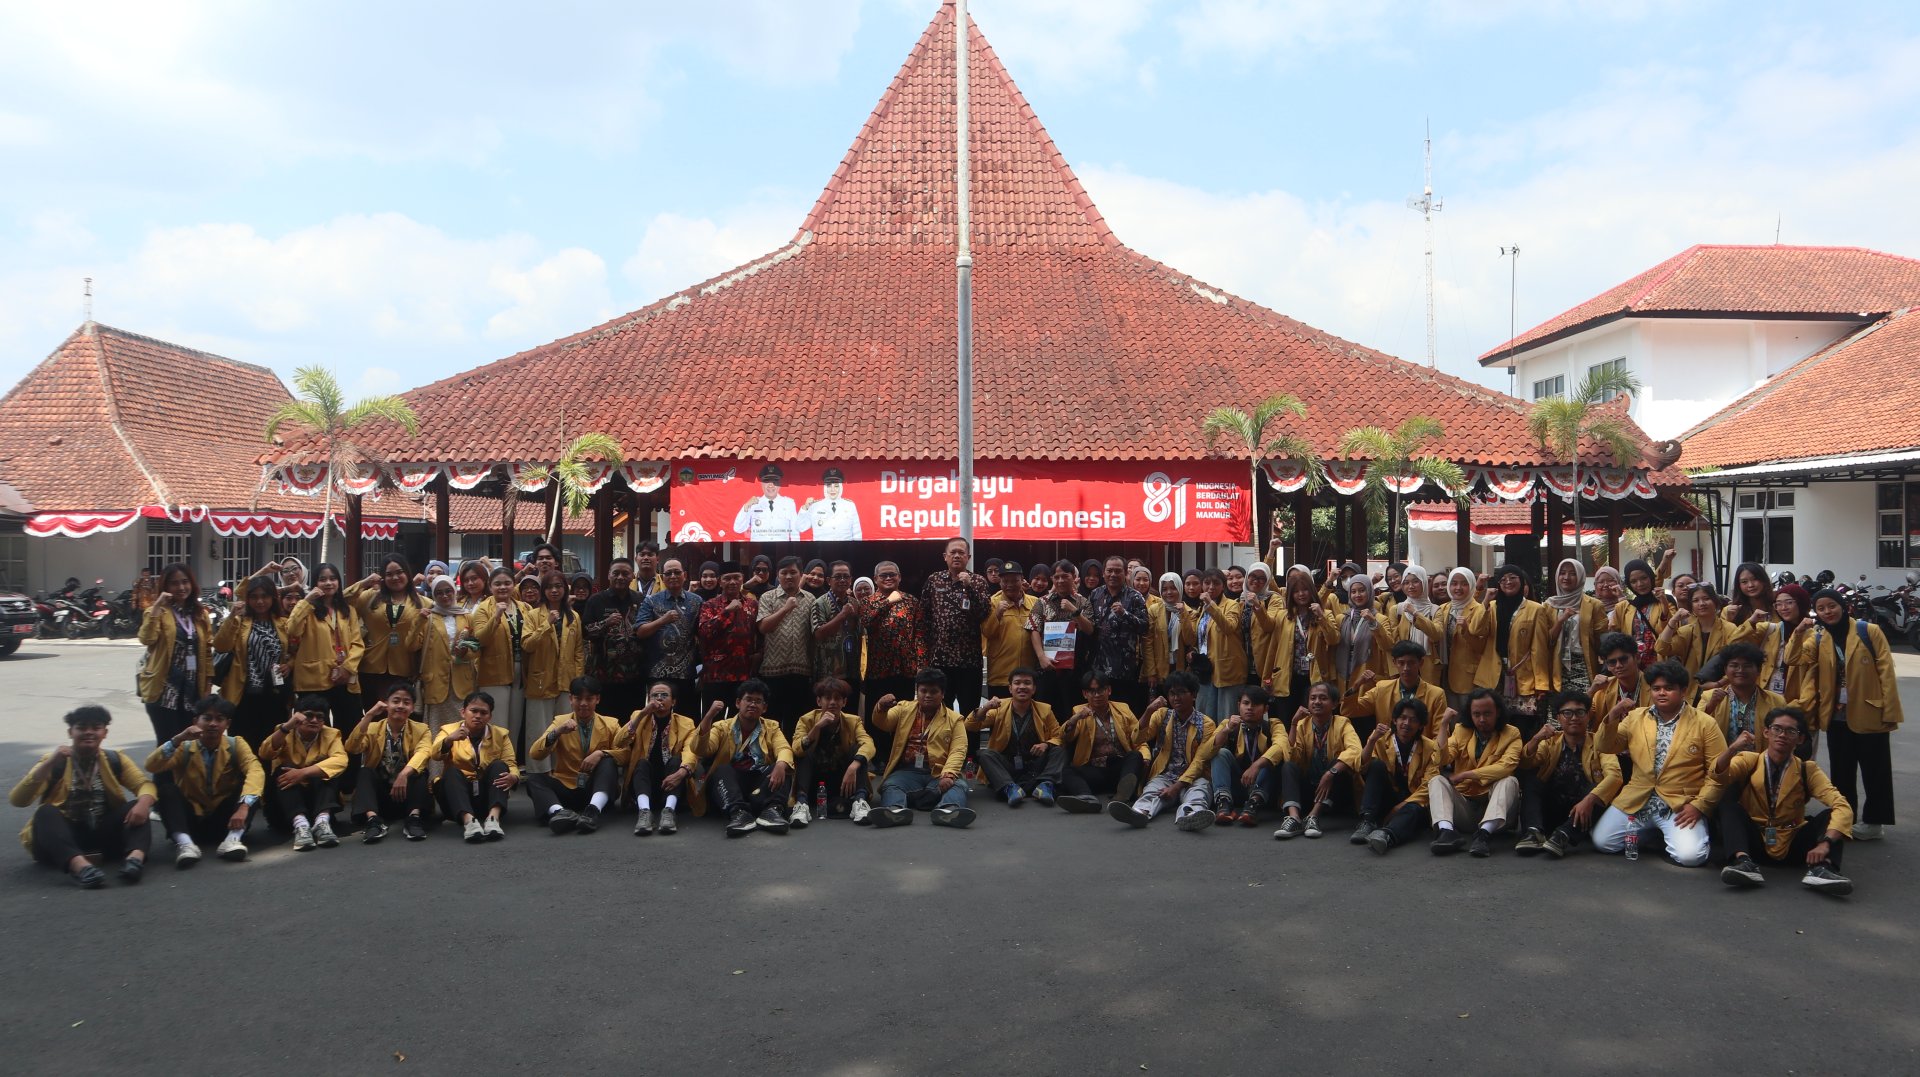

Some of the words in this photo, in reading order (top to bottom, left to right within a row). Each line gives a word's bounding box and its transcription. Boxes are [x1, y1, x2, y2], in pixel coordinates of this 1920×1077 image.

[1196, 482, 1236, 490] INDONESIA
[1196, 492, 1240, 500] BERDAULAT
[1143, 471, 1191, 530] 81
[1196, 501, 1213, 509] ADIL
[880, 503, 994, 533] Repubik
[1002, 504, 1126, 529] Indonesia
[1196, 511, 1231, 519] MAKMUR
